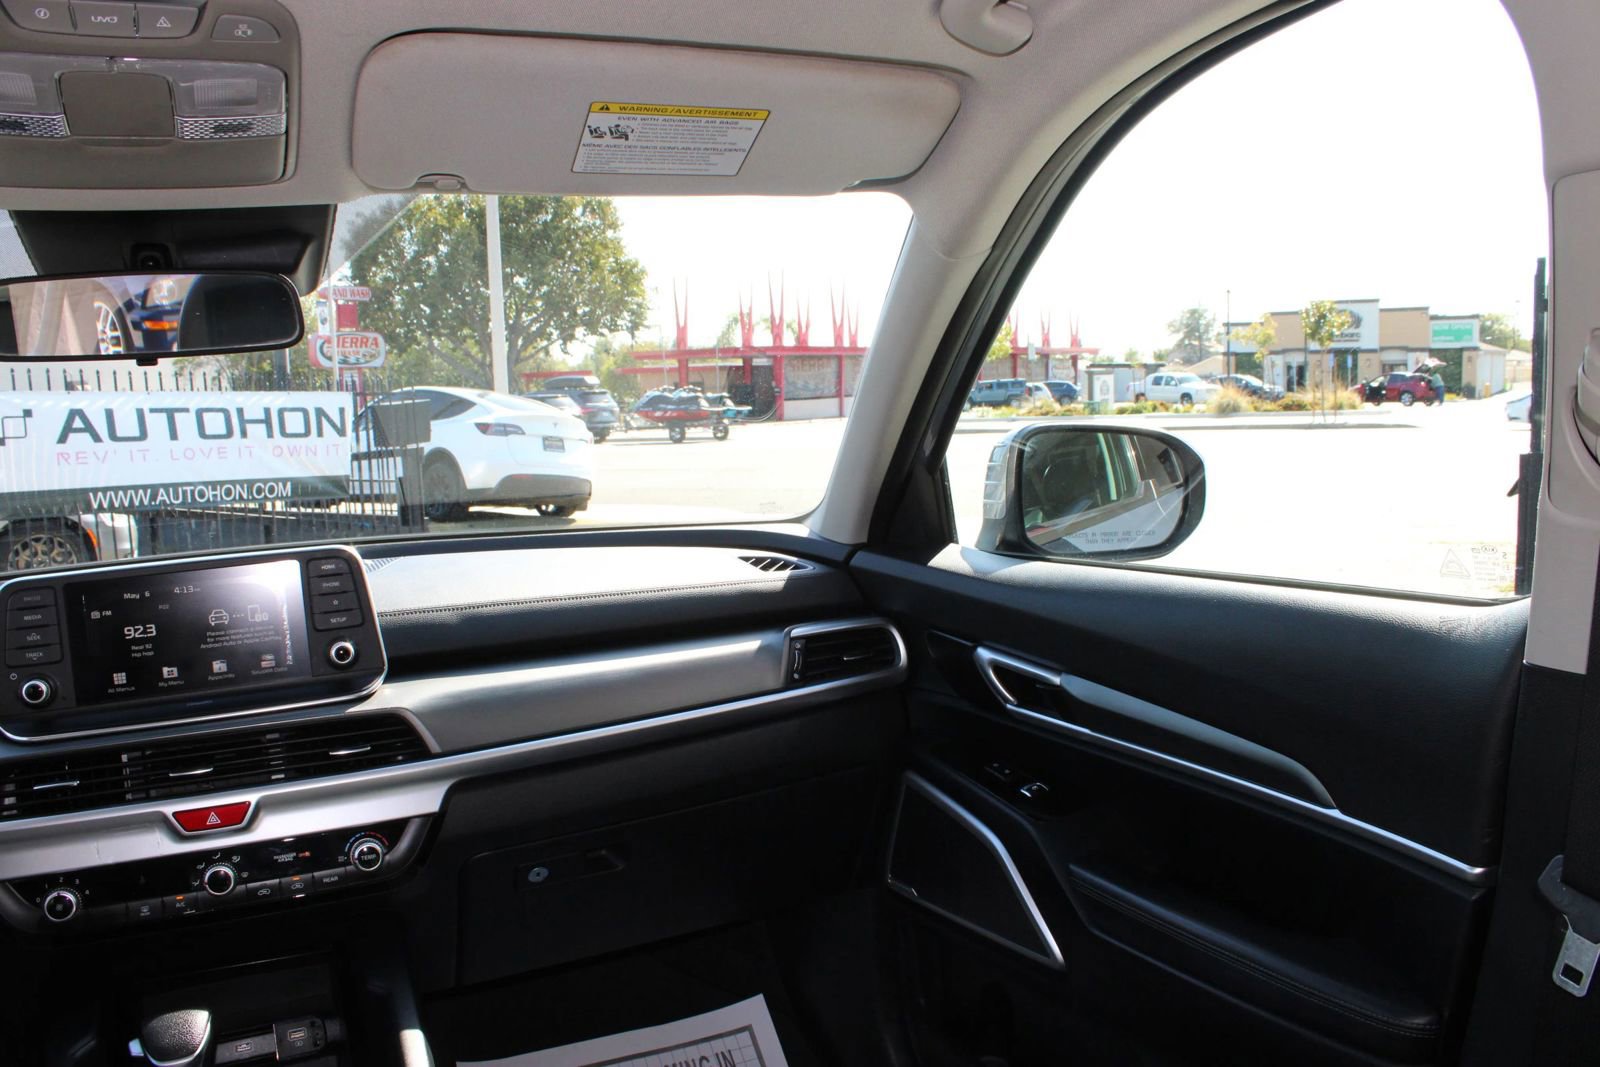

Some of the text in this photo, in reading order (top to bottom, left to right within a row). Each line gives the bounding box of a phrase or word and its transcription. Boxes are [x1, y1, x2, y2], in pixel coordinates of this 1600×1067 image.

[619, 105, 668, 113] WARNING
[56, 406, 347, 444] AUTOHON
[170, 446, 228, 461] LOVE
[272, 444, 318, 458] OWN
[89, 481, 291, 509] WWW.AUTOHON.COM
[123, 592, 140, 600] May
[102, 609, 112, 617] FM
[124, 624, 157, 640] 92.3
